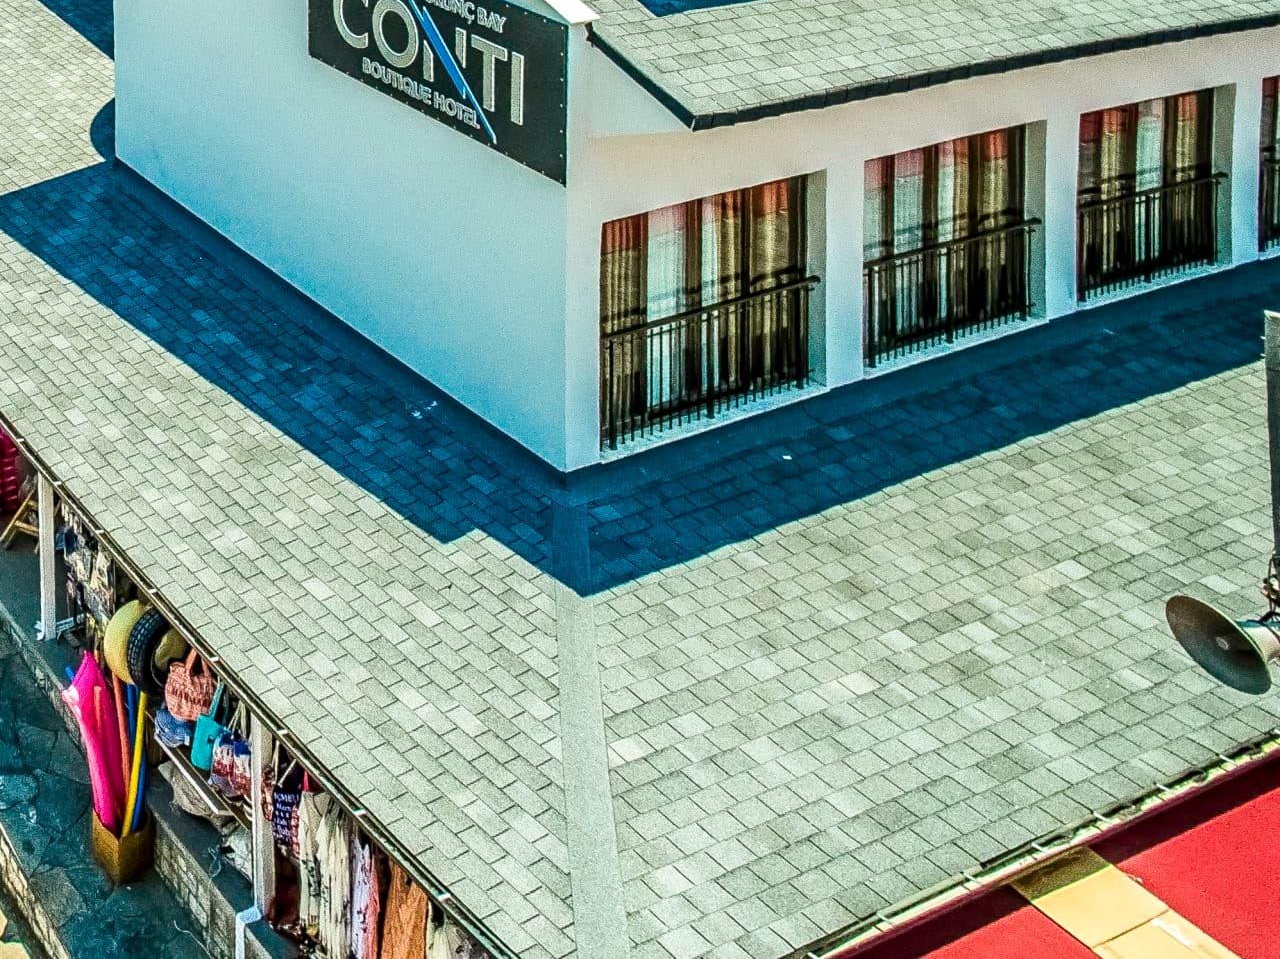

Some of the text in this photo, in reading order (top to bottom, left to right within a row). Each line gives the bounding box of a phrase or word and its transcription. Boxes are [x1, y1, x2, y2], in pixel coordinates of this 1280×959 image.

[476, 6, 507, 34] BAY
[362, 56, 481, 129] BOUTIQUE HOTEL
